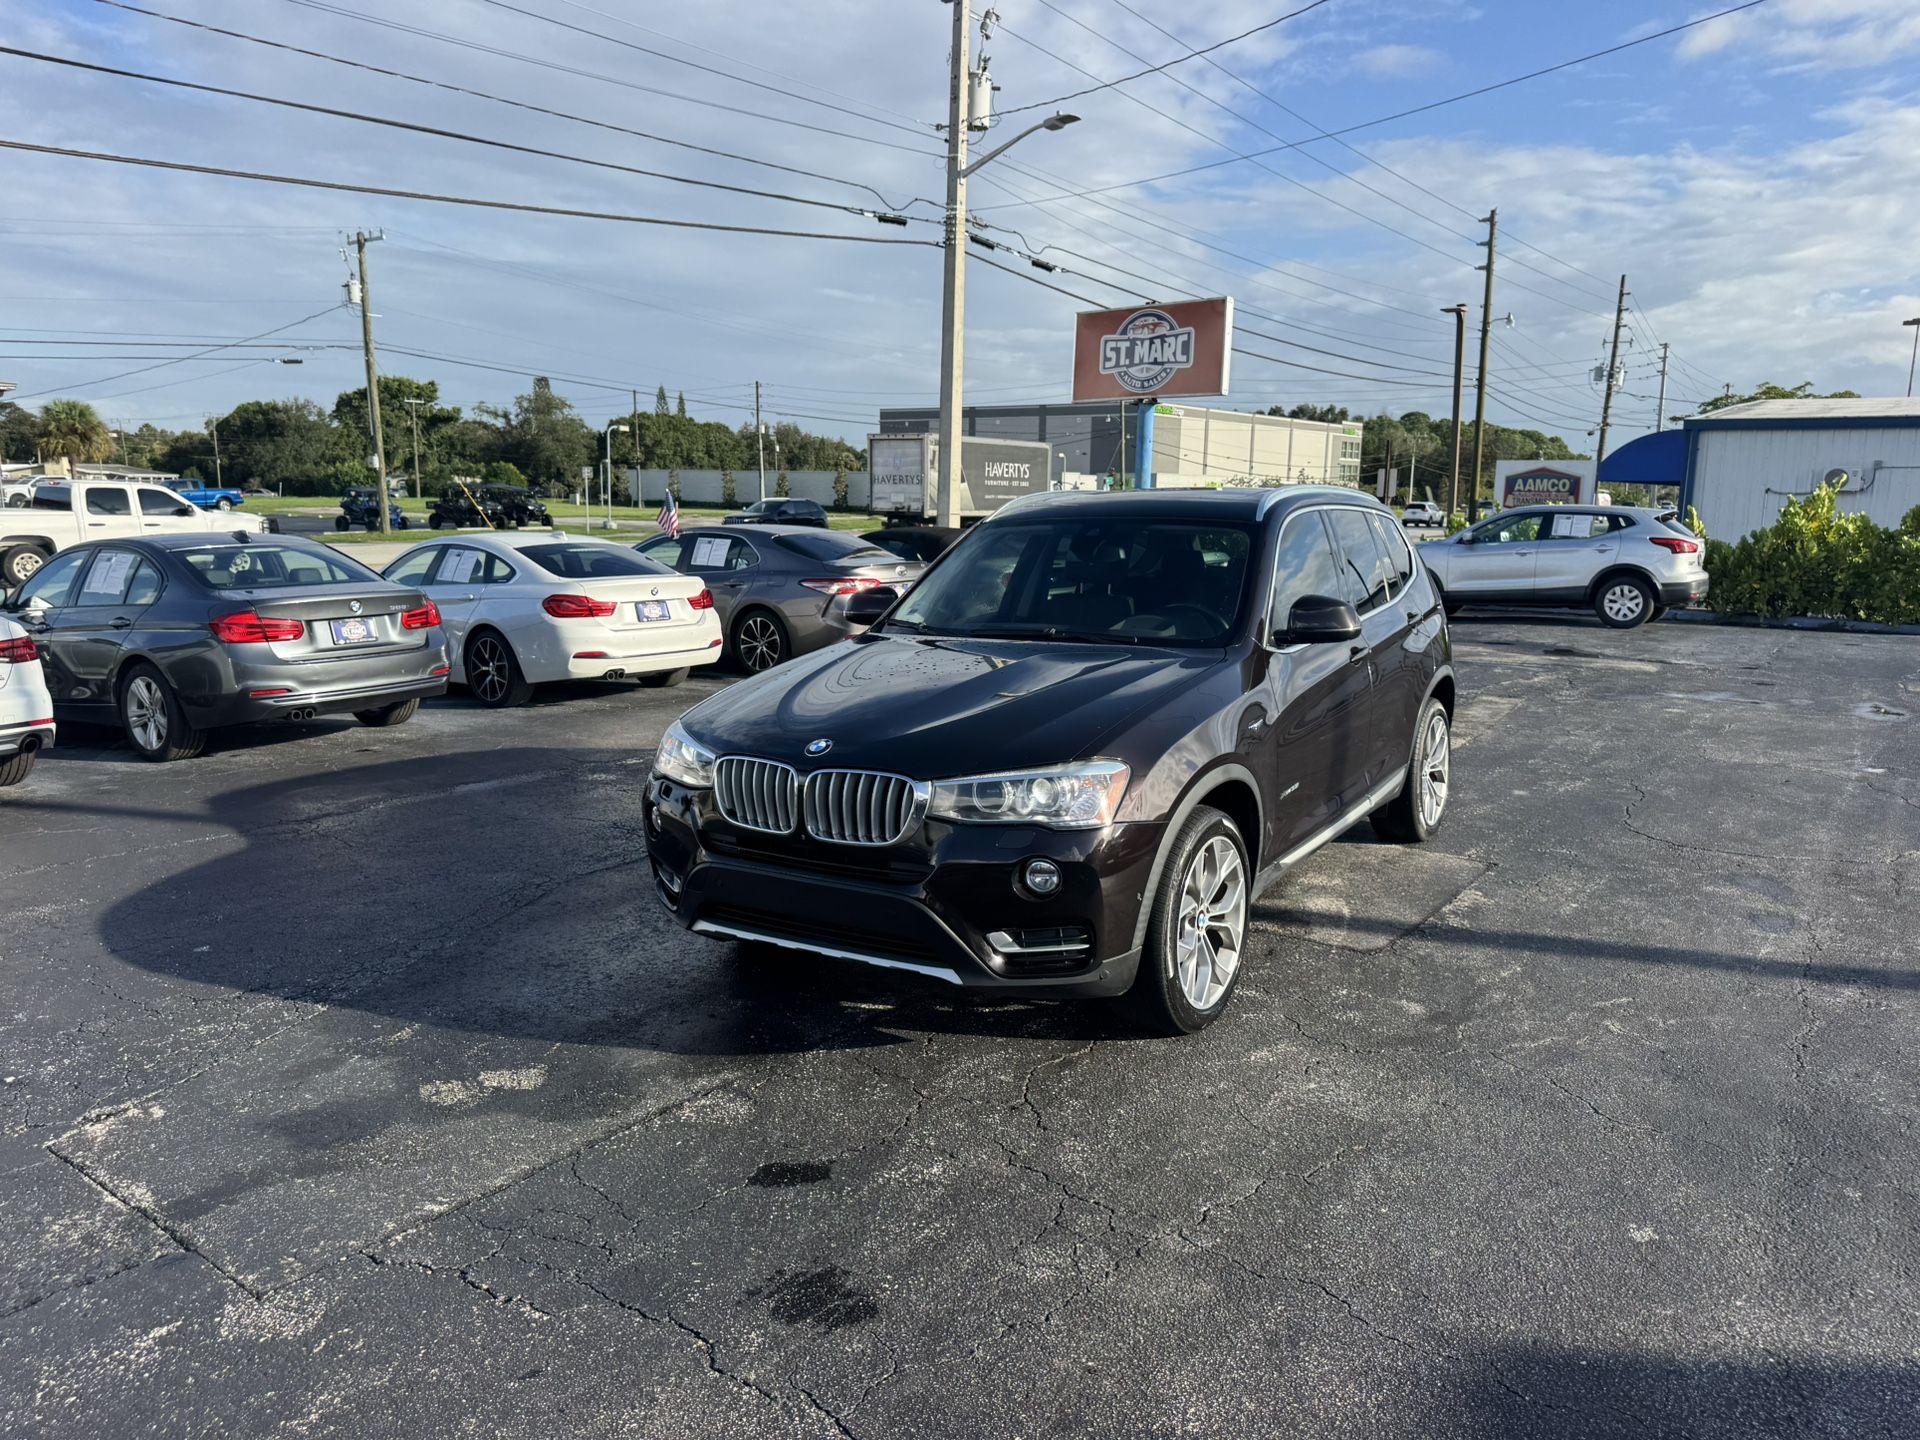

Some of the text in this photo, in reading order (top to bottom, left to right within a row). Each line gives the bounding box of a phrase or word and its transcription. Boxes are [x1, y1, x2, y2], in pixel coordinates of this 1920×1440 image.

[1104, 333, 1188, 368] ST. MARC
[1122, 372, 1167, 388] AUTO SALES
[985, 461, 1030, 478] HAVERTYS
[873, 474, 920, 485] HAVERTYS
[1514, 478, 1570, 492] AAMCO
